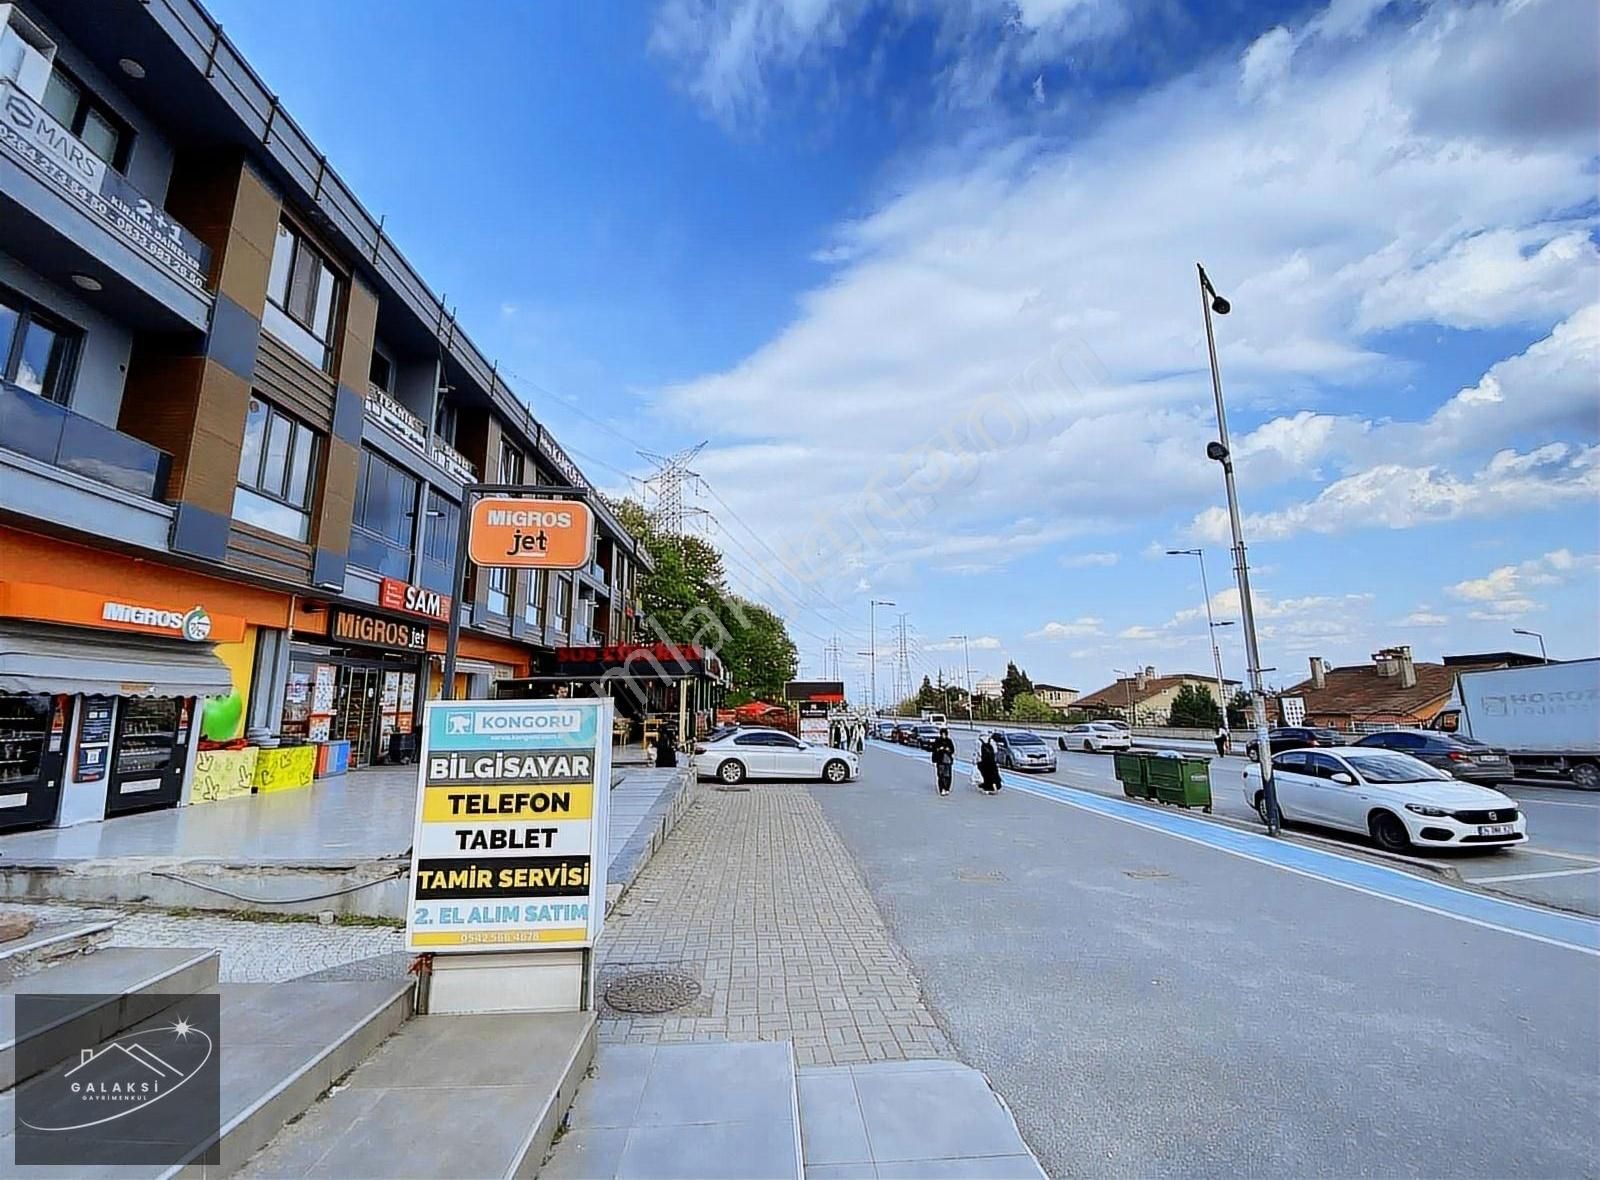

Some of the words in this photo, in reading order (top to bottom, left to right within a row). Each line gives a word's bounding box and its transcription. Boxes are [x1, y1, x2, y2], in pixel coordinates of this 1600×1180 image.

[36, 118, 97, 177] MARS
[507, 529, 548, 556] jet
[405, 586, 441, 617] SAM
[408, 627, 425, 648] jet
[482, 715, 574, 729] KONGORU
[430, 752, 590, 780] BİLGİSAYAR
[448, 792, 571, 815] TELEFON
[456, 828, 558, 850] TABLET
[418, 865, 493, 890] TAMİR
[499, 862, 590, 887] SERVİSİ
[414, 907, 433, 925] 2.
[440, 906, 465, 924] EL
[467, 905, 519, 924] ALIM
[524, 903, 589, 922] SATIM
